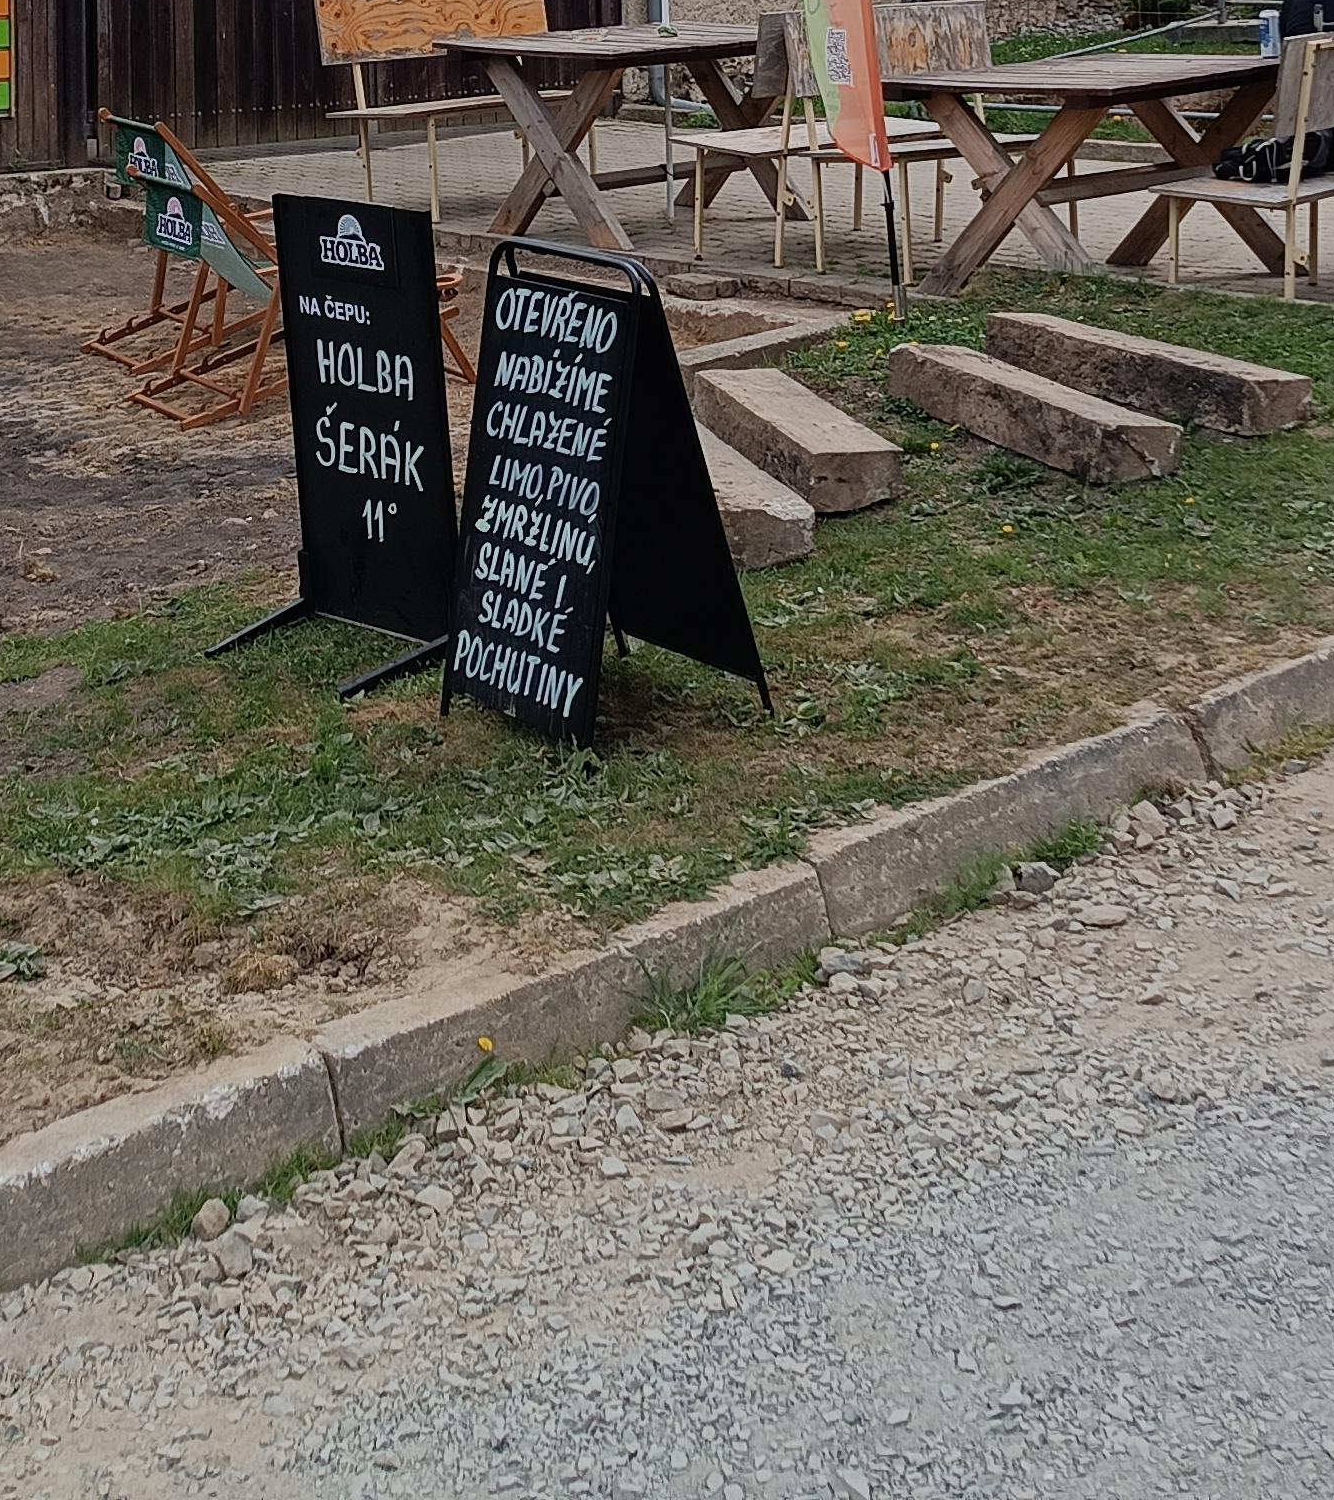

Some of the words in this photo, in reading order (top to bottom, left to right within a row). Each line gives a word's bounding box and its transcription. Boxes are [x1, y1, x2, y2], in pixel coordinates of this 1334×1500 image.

[157, 213, 192, 245] HOLBA
[320, 236, 384, 270] HOLBA
[299, 295, 321, 316] NA
[324, 295, 370, 325] ČEPU:
[496, 288, 618, 354] OTEVŘENO
[317, 338, 414, 400] HOLBA
[493, 349, 613, 413] NABÍZÍME
[316, 402, 424, 492] ŠERÁK
[486, 401, 612, 462] CHLAZENÉ
[362, 499, 398, 542] 11°
[474, 541, 556, 600] SLANÉ
[555, 574, 567, 609] I
[478, 590, 574, 654] SLADKÉ
[454, 630, 583, 718] POCHUTINY
